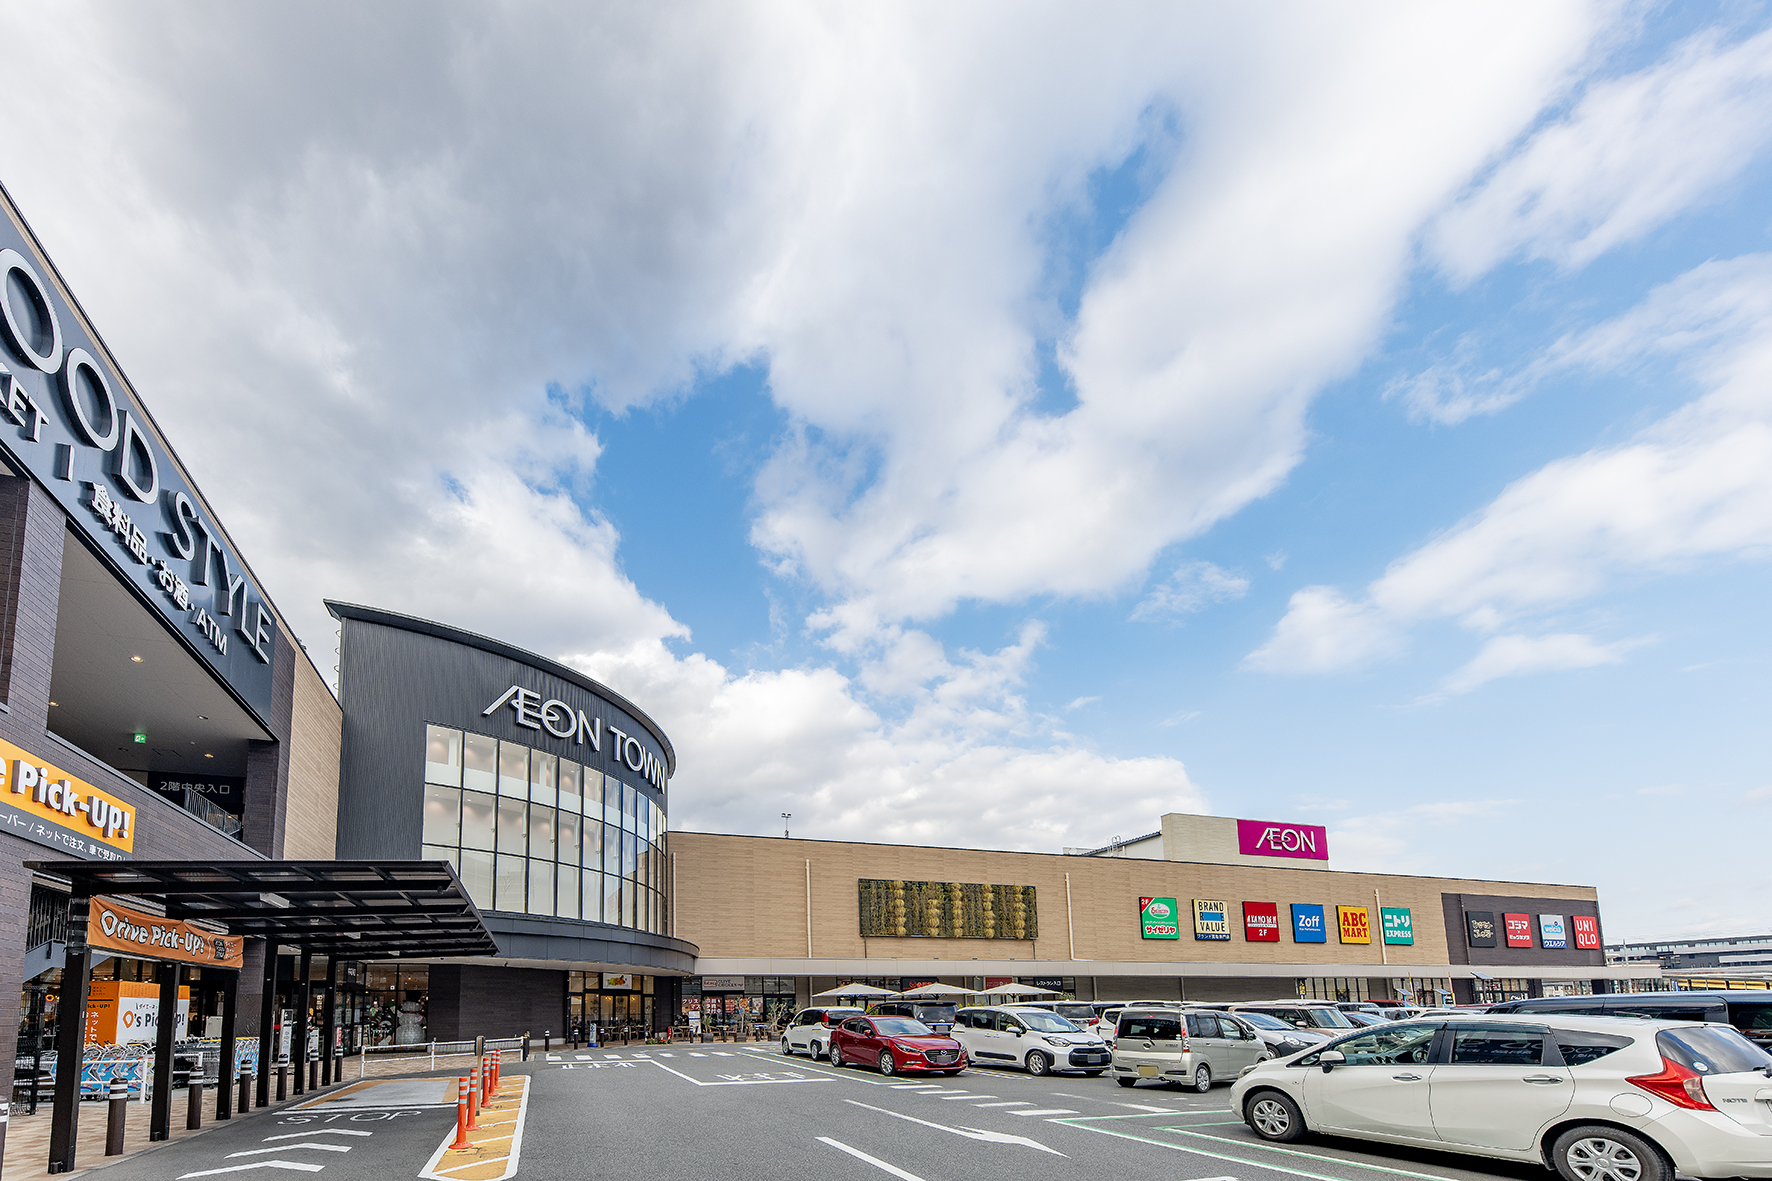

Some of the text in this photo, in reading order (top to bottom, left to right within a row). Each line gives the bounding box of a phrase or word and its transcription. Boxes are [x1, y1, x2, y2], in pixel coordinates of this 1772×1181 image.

[171, 491, 272, 665] STYLE
[609, 725, 665, 794] TOWN
[160, 781, 230, 794] 2階中央入口
[1198, 901, 1224, 911] BRAND
[1298, 915, 1320, 927] Zoff
[1342, 912, 1367, 927] ABC
[1384, 914, 1410, 927] ニトリ
[1507, 920, 1528, 930] コジマ
[1145, 925, 1177, 935] サイゼリヤ
[1200, 922, 1226, 932] VALUE
[1576, 920, 1594, 932] UNI
[1343, 928, 1367, 937] MART
[1578, 933, 1597, 947] QLO
[277, 1110, 422, 1125] STOP
